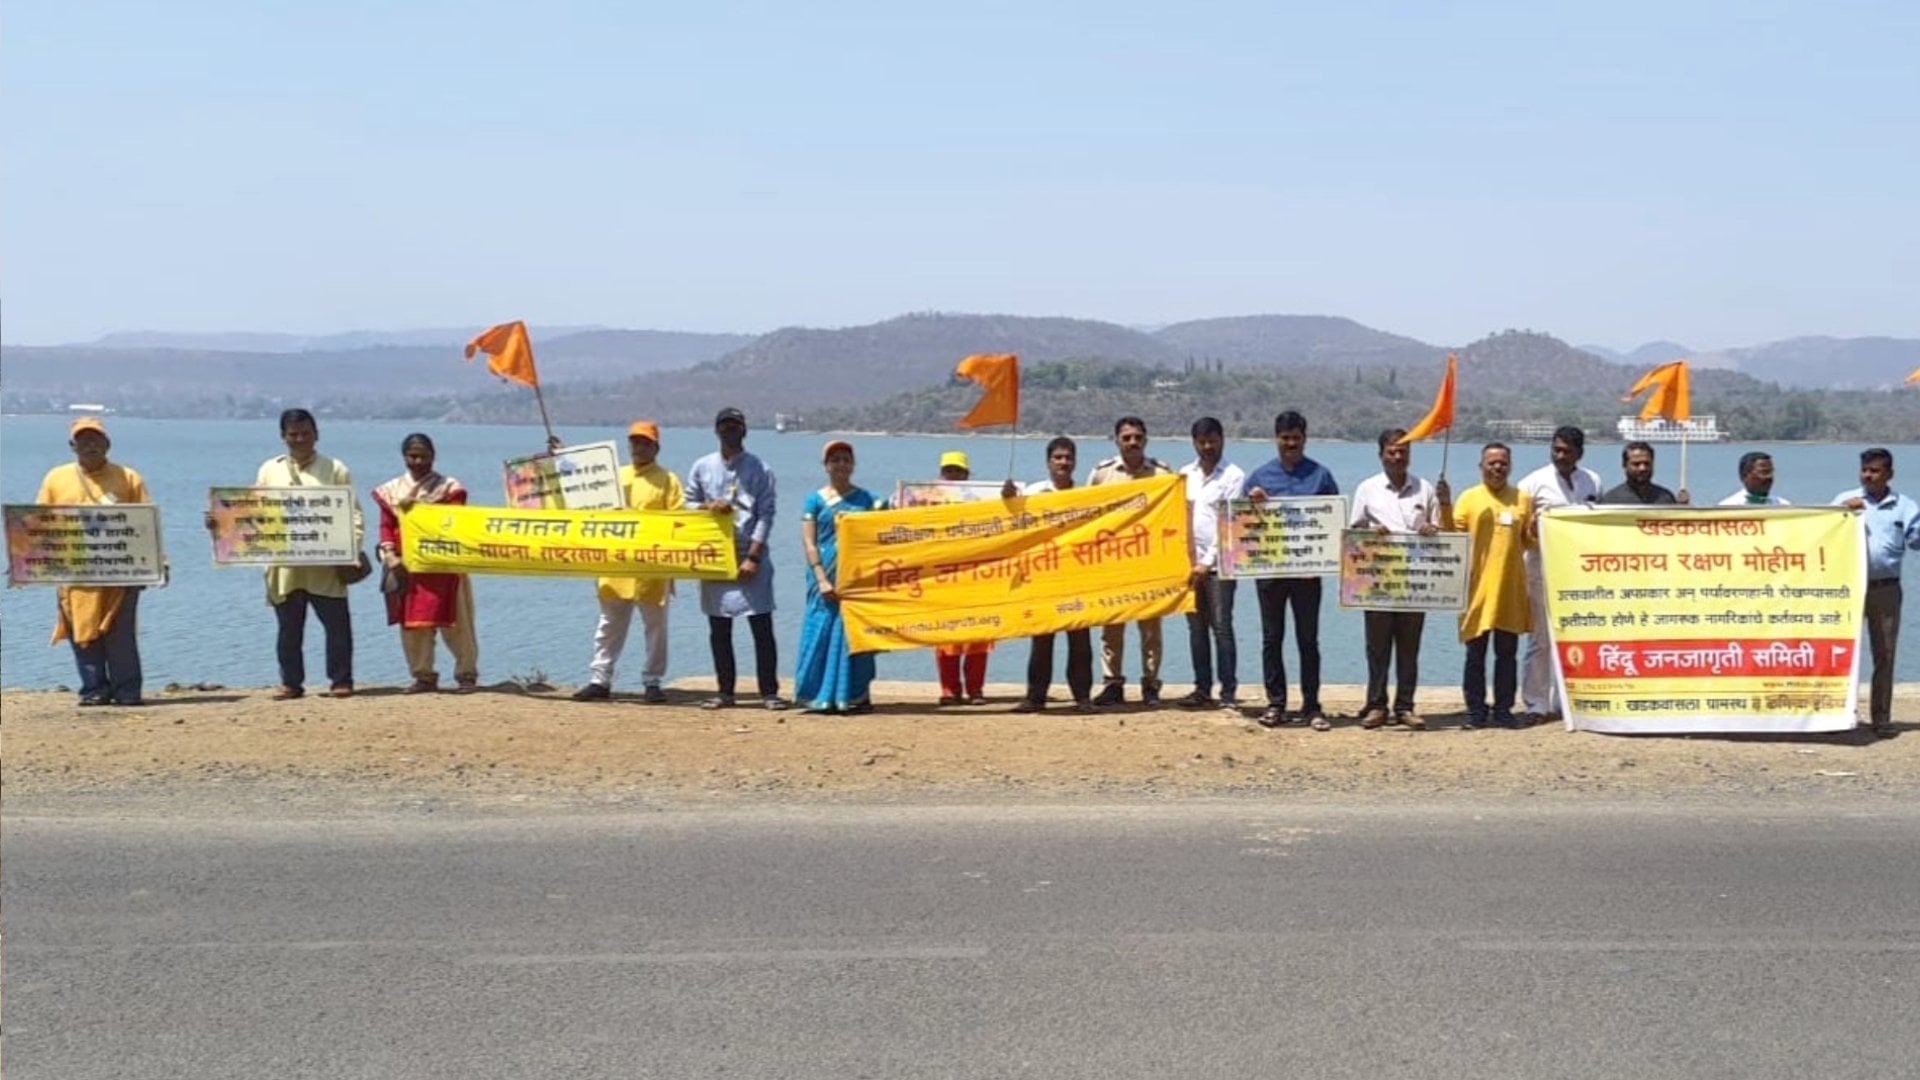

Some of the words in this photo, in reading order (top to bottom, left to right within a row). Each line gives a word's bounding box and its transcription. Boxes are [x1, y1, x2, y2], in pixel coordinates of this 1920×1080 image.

[485, 517, 572, 536] सनातन
[581, 514, 640, 539] संस्था
[1635, 518, 1766, 536] खडकवासला
[934, 540, 1060, 584] जनजागृती
[1072, 524, 1151, 566] समिती
[1580, 553, 1668, 574] जलाशय
[1678, 553, 1733, 572] रक्षण
[1741, 545, 1807, 574] मोहीम
[1819, 546, 1826, 572] !
[1557, 585, 1615, 602] उत्सवातील
[1619, 588, 1670, 600] अपप्रकार
[1700, 584, 1775, 599] पर्यावरणहानी
[1611, 611, 1636, 627] होणे
[1639, 611, 1650, 627] हे
[1819, 610, 1842, 626] आहे
[1598, 643, 1640, 677] हिंदू
[1643, 641, 1744, 675] जनजागृती
[1752, 641, 1815, 669] समिती
[1625, 698, 1701, 713] खडकवासला
